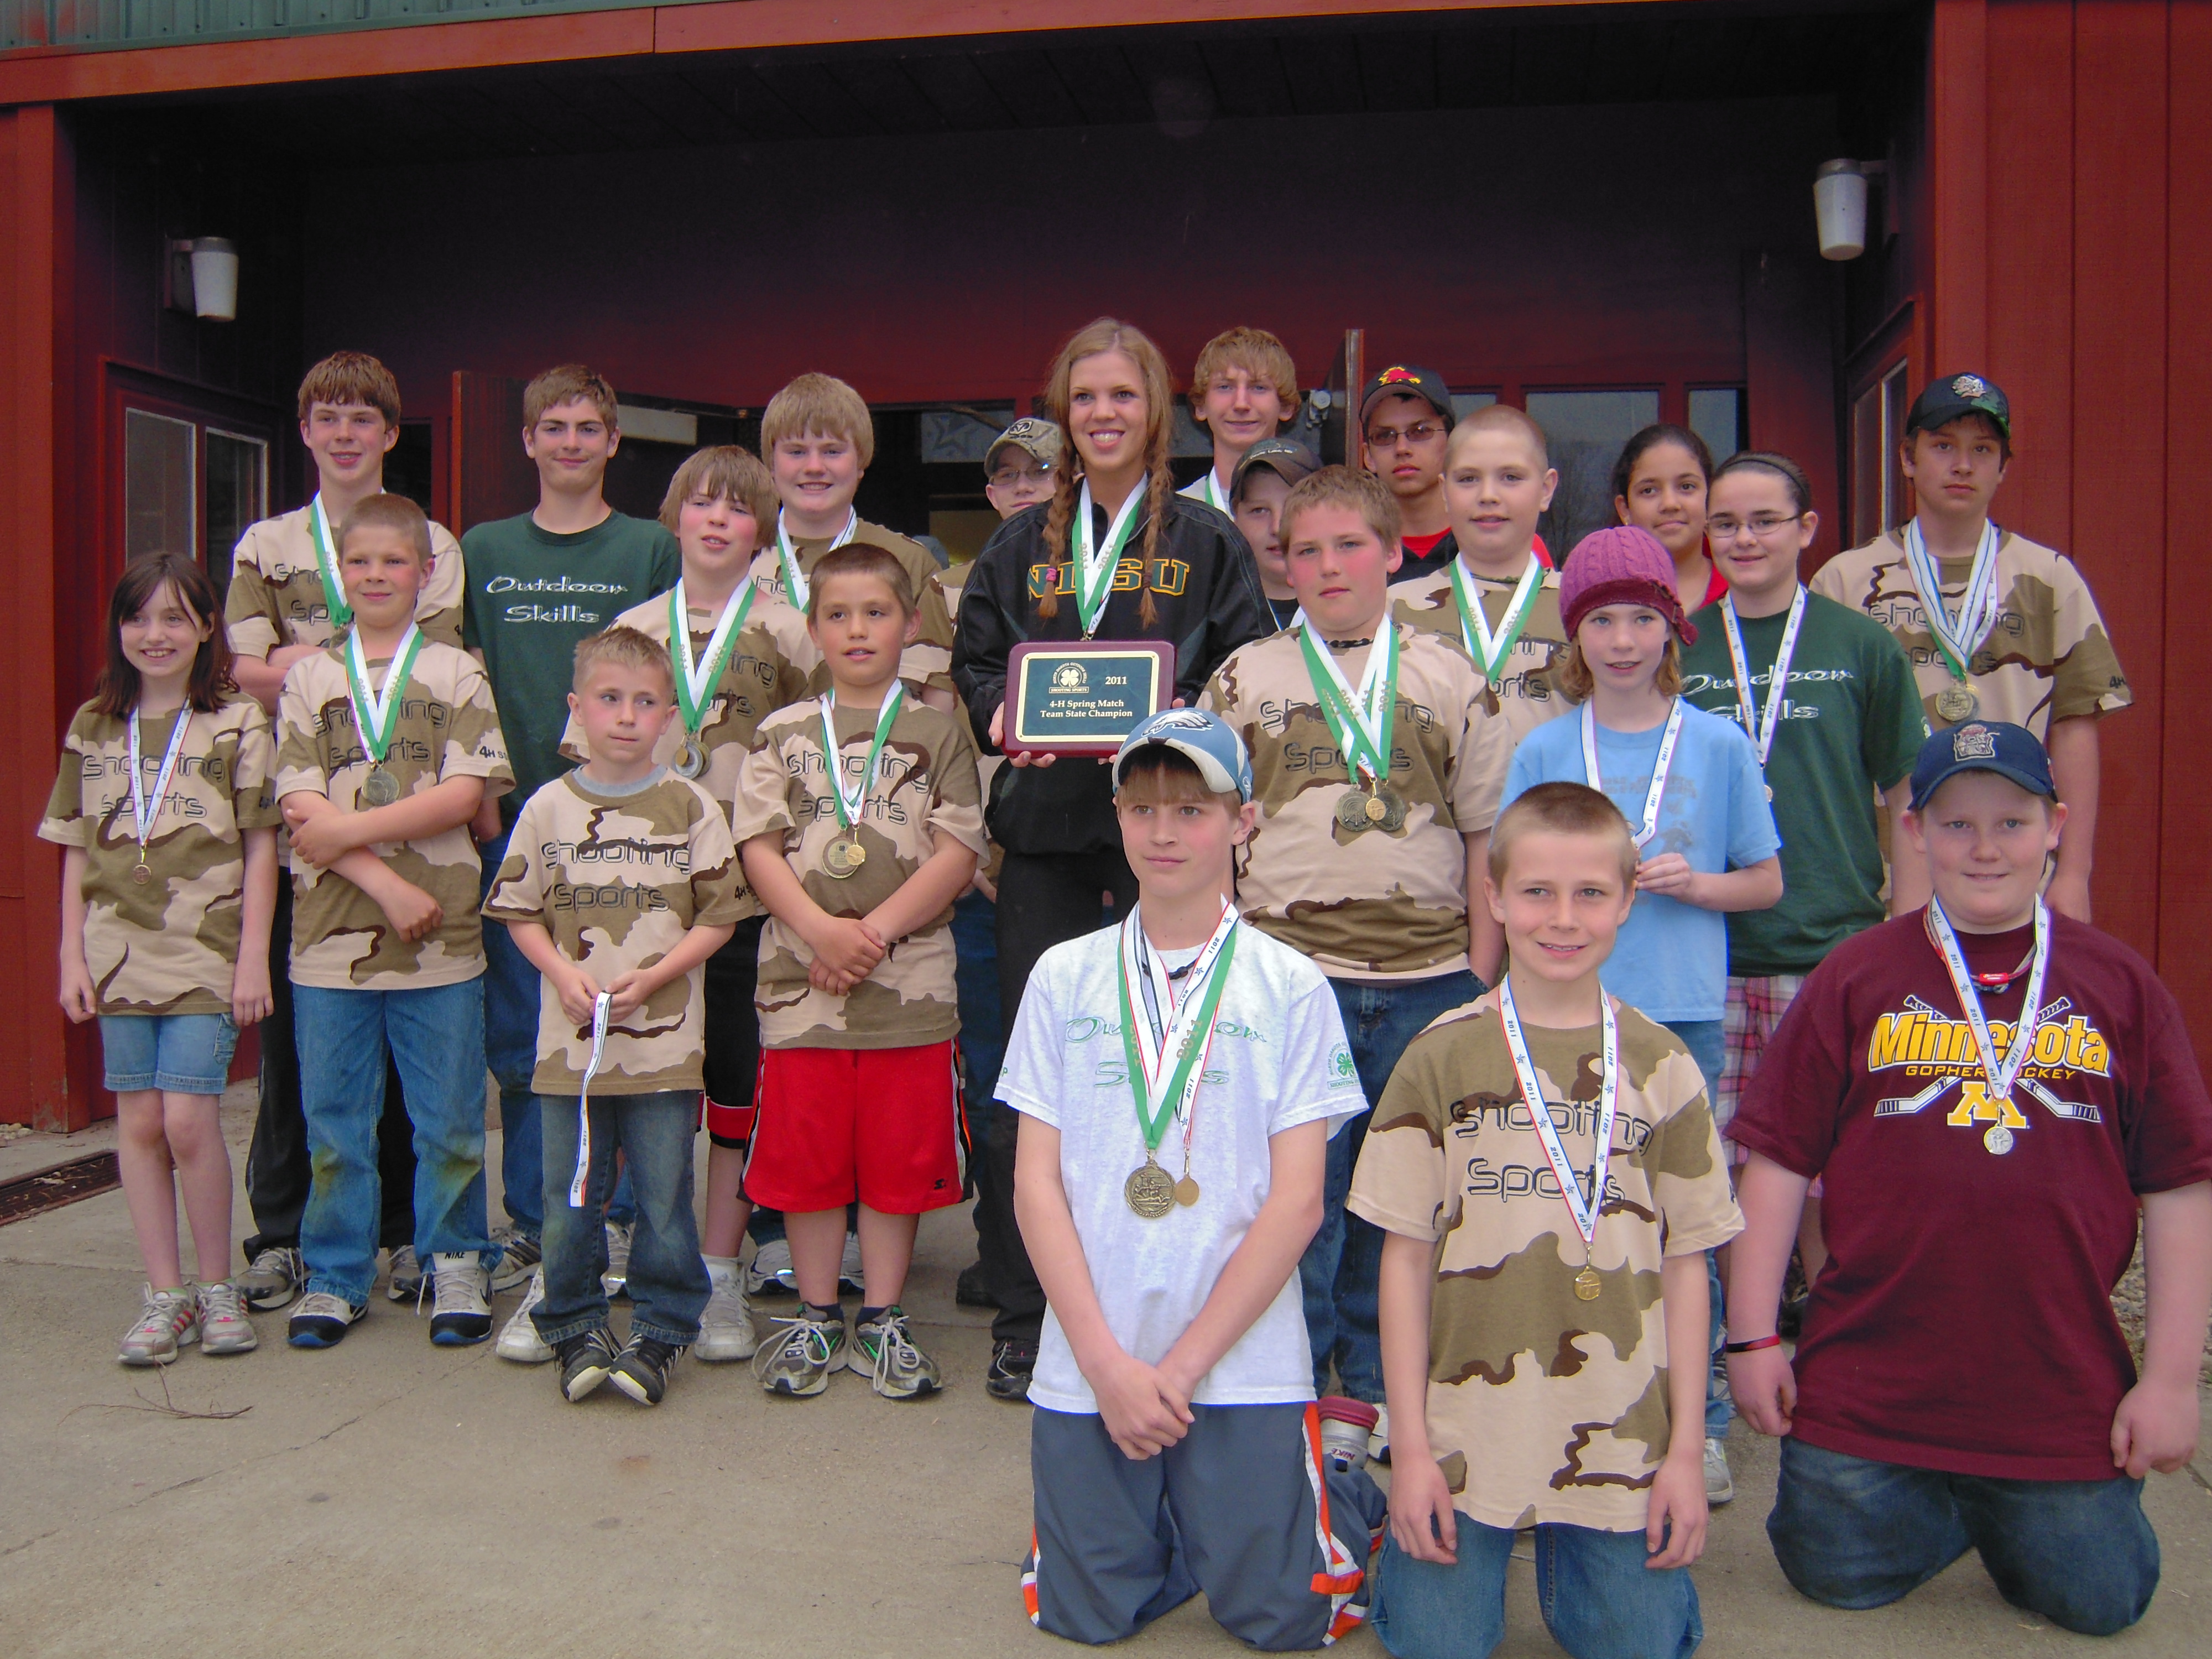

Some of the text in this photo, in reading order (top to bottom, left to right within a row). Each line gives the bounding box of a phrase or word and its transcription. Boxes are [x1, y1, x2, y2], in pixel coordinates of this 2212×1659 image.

[1078, 542, 1088, 572] 2011
[1098, 543, 1118, 570] 2011
[486, 576, 628, 594] Outdoor
[504, 605, 599, 623] Skills
[1468, 607, 1481, 633] 2011
[1504, 609, 1523, 635] 2011
[677, 644, 688, 672] 2011
[708, 645, 728, 674] 2011
[356, 678, 369, 705] 2011
[387, 675, 404, 701] 2011
[1105, 676, 1127, 685] 2011
[1494, 671, 1551, 702] orts
[1679, 665, 1854, 697] Oudoor
[1067, 700, 1096, 709] Spring
[1337, 689, 1360, 721] 2011
[1379, 680, 1392, 712] 2011
[312, 697, 447, 739] Shing
[1088, 709, 1133, 719] Champion
[1260, 698, 1434, 734] Shng
[329, 737, 430, 773] Sprts
[479, 745, 496, 759] 4H
[1283, 743, 1415, 775] Spos
[1661, 747, 1669, 761] 2011
[83, 752, 226, 783] Shooing
[787, 750, 932, 794] Shoing
[100, 792, 207, 822] Sprts
[797, 791, 908, 826] Sprts
[554, 882, 670, 914] Sports
[734, 886, 747, 900] 4H
[1932, 911, 1941, 924] 2011
[1208, 937, 1220, 954] 2011
[1950, 954, 1960, 969] 2011
[1177, 989, 1189, 1006] 2011
[1065, 1016, 1267, 1044] Ouor
[1507, 1020, 1517, 1037] 2011
[1970, 1008, 1981, 1026] 2011
[1176, 1019, 1203, 1061] 2011
[1868, 1010, 2110, 1078] Minneota
[2008, 1048, 2020, 1068] 2011
[1905, 1065, 2076, 1080] GOPHER CKEY
[1988, 1068, 2000, 1086] 2011
[1186, 1078, 1194, 1099] 2011
[1525, 1082, 1536, 1100] 2011
[1602, 1112, 1610, 1135] 2011
[1550, 1146, 1563, 1166] 2011
